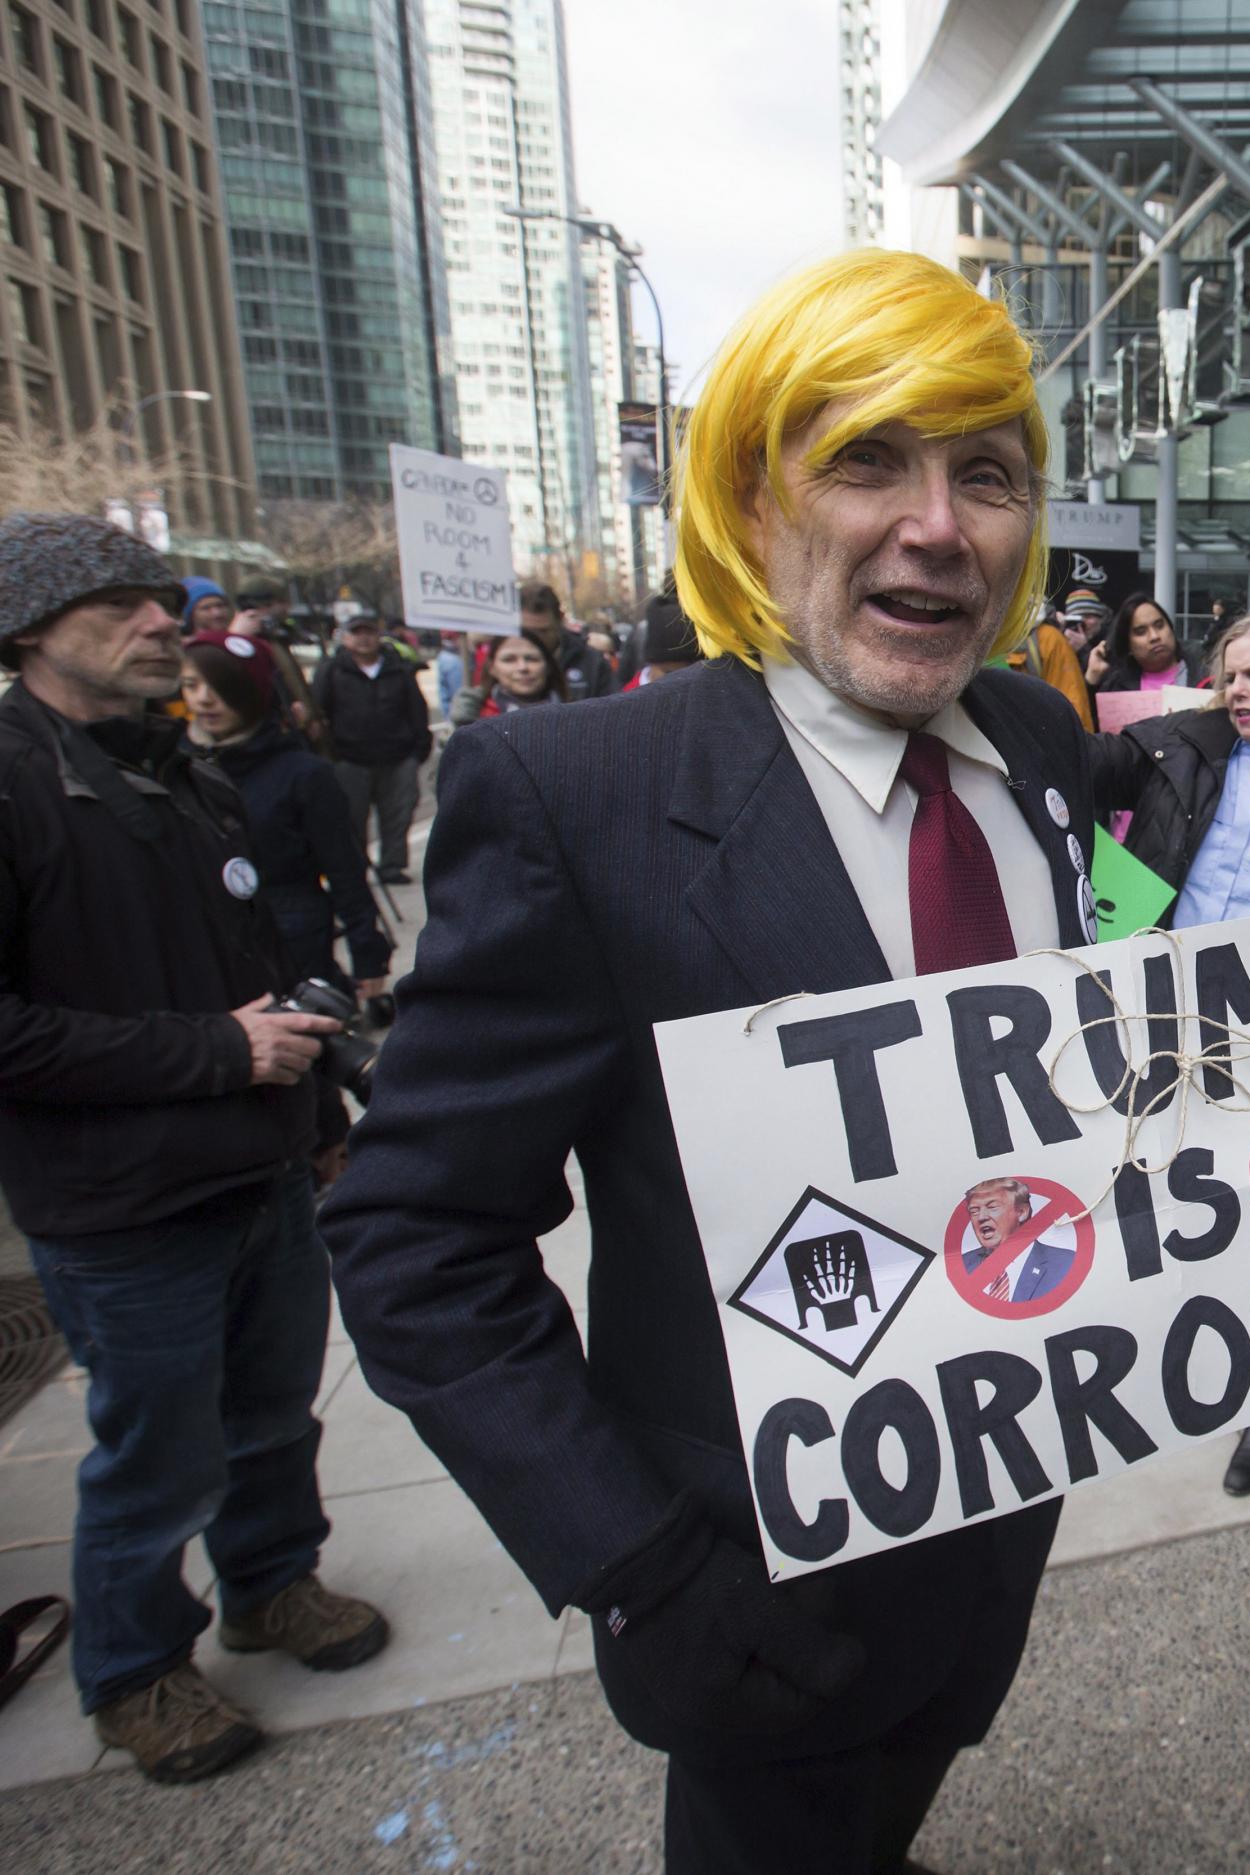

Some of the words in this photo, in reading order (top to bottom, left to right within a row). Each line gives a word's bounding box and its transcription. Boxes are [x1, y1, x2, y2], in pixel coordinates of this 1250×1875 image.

[446, 501, 476, 525] NO
[1054, 508, 1124, 526] TRUMP
[423, 520, 492, 555] ROOM
[1112, 1147, 1241, 1283] IS
